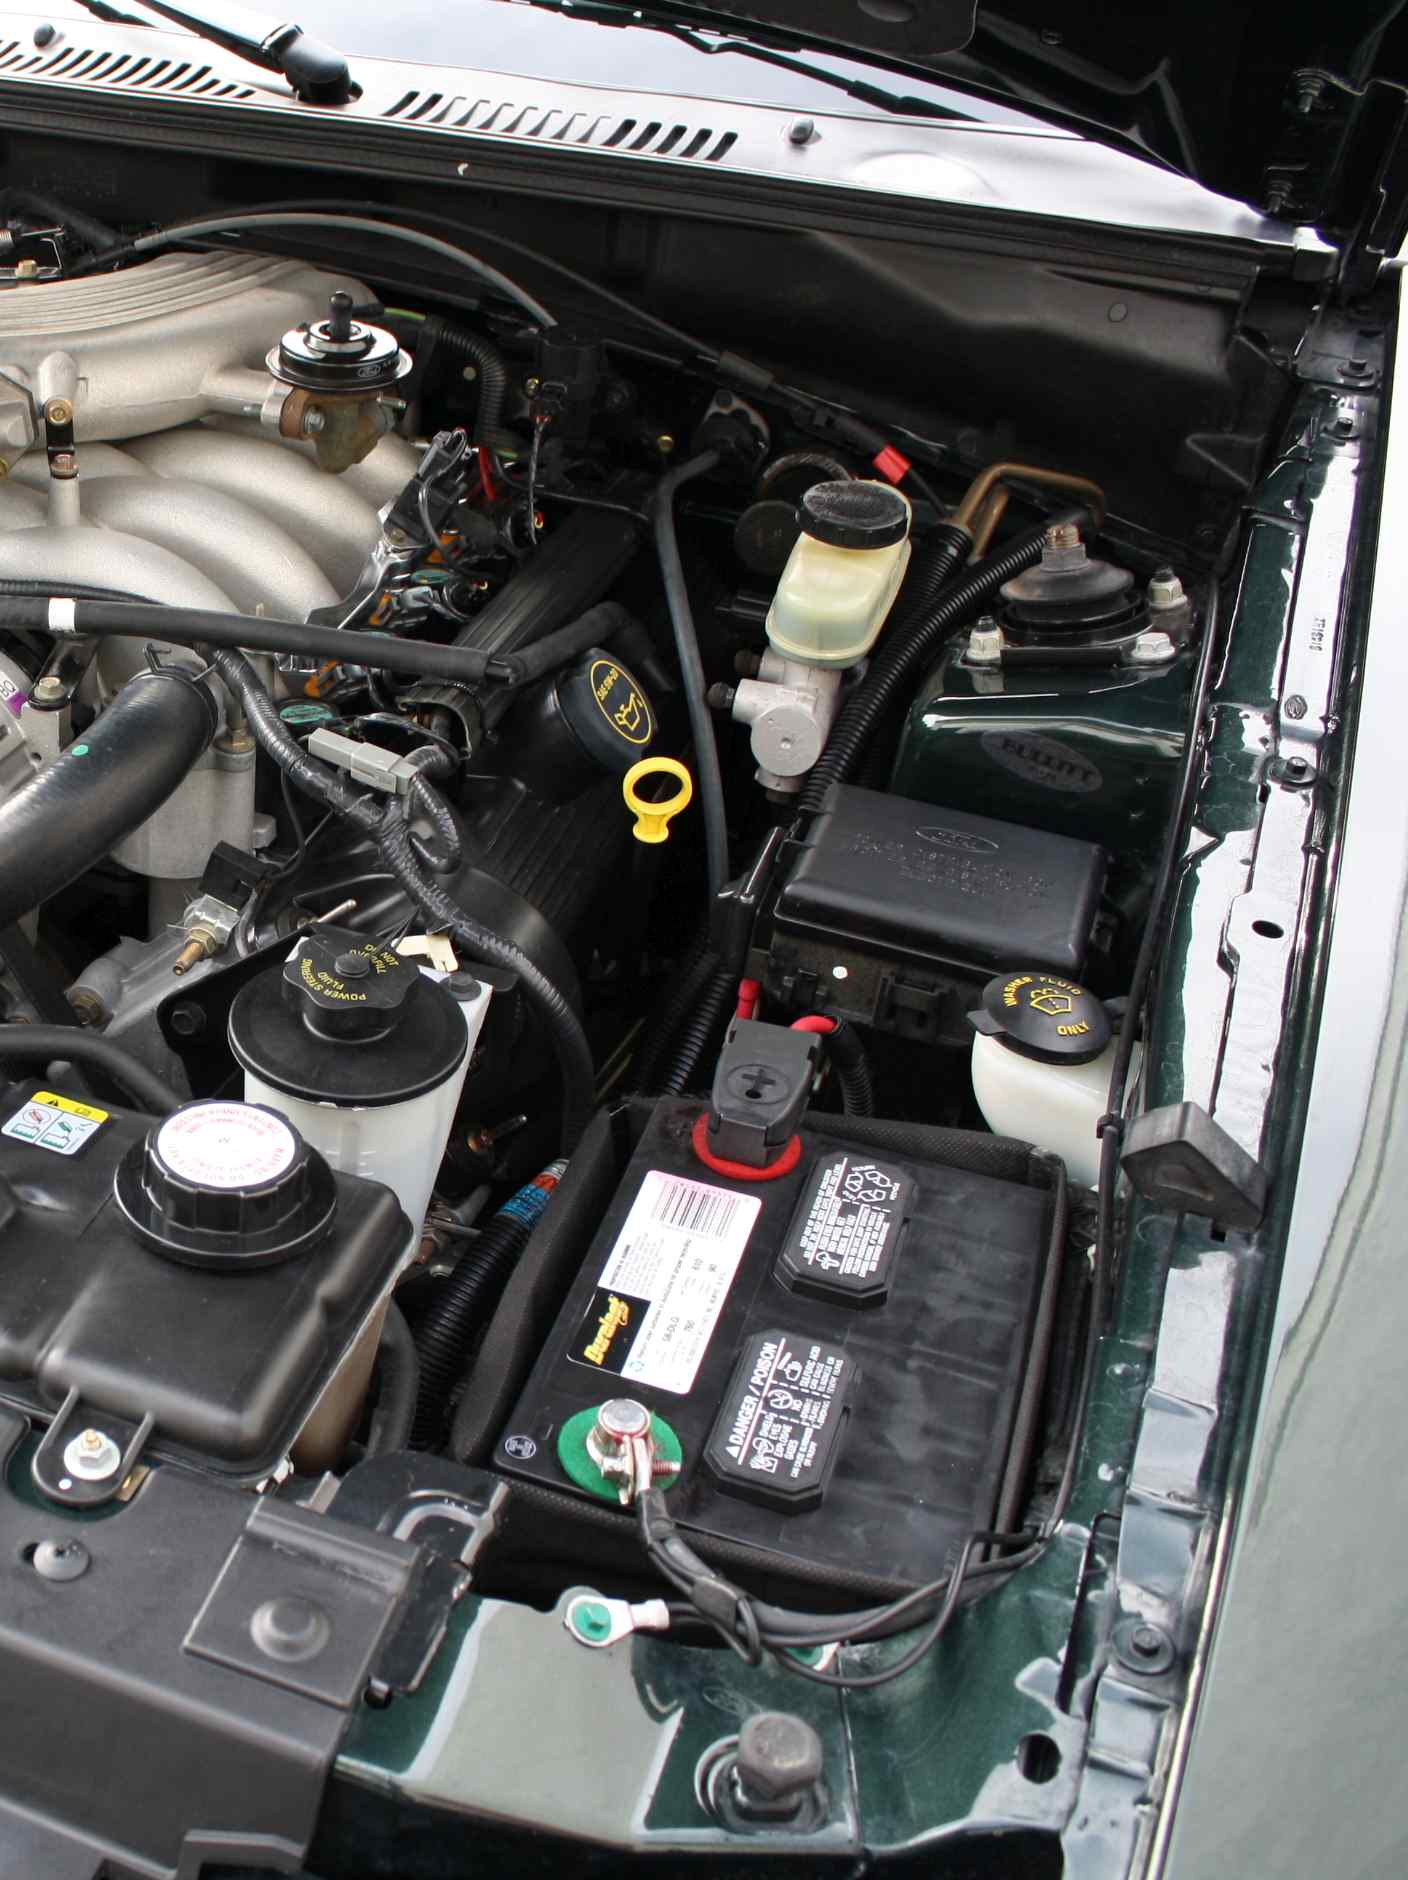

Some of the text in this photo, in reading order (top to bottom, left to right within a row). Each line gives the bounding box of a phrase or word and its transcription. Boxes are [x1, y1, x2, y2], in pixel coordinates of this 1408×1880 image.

[1002, 736, 1093, 781] BULLITT
[380, 952, 400, 966] NOT
[301, 958, 367, 1001] POWER STEERING
[318, 971, 344, 990] FLUID
[1002, 976, 1081, 1007] WASHER FLUID
[1057, 1021, 1089, 1036] ONLY
[728, 1395, 759, 1446] DANGER
[750, 1342, 778, 1386] POISON
[791, 1399, 803, 1412] NO
[769, 1423, 783, 1440] EYES
